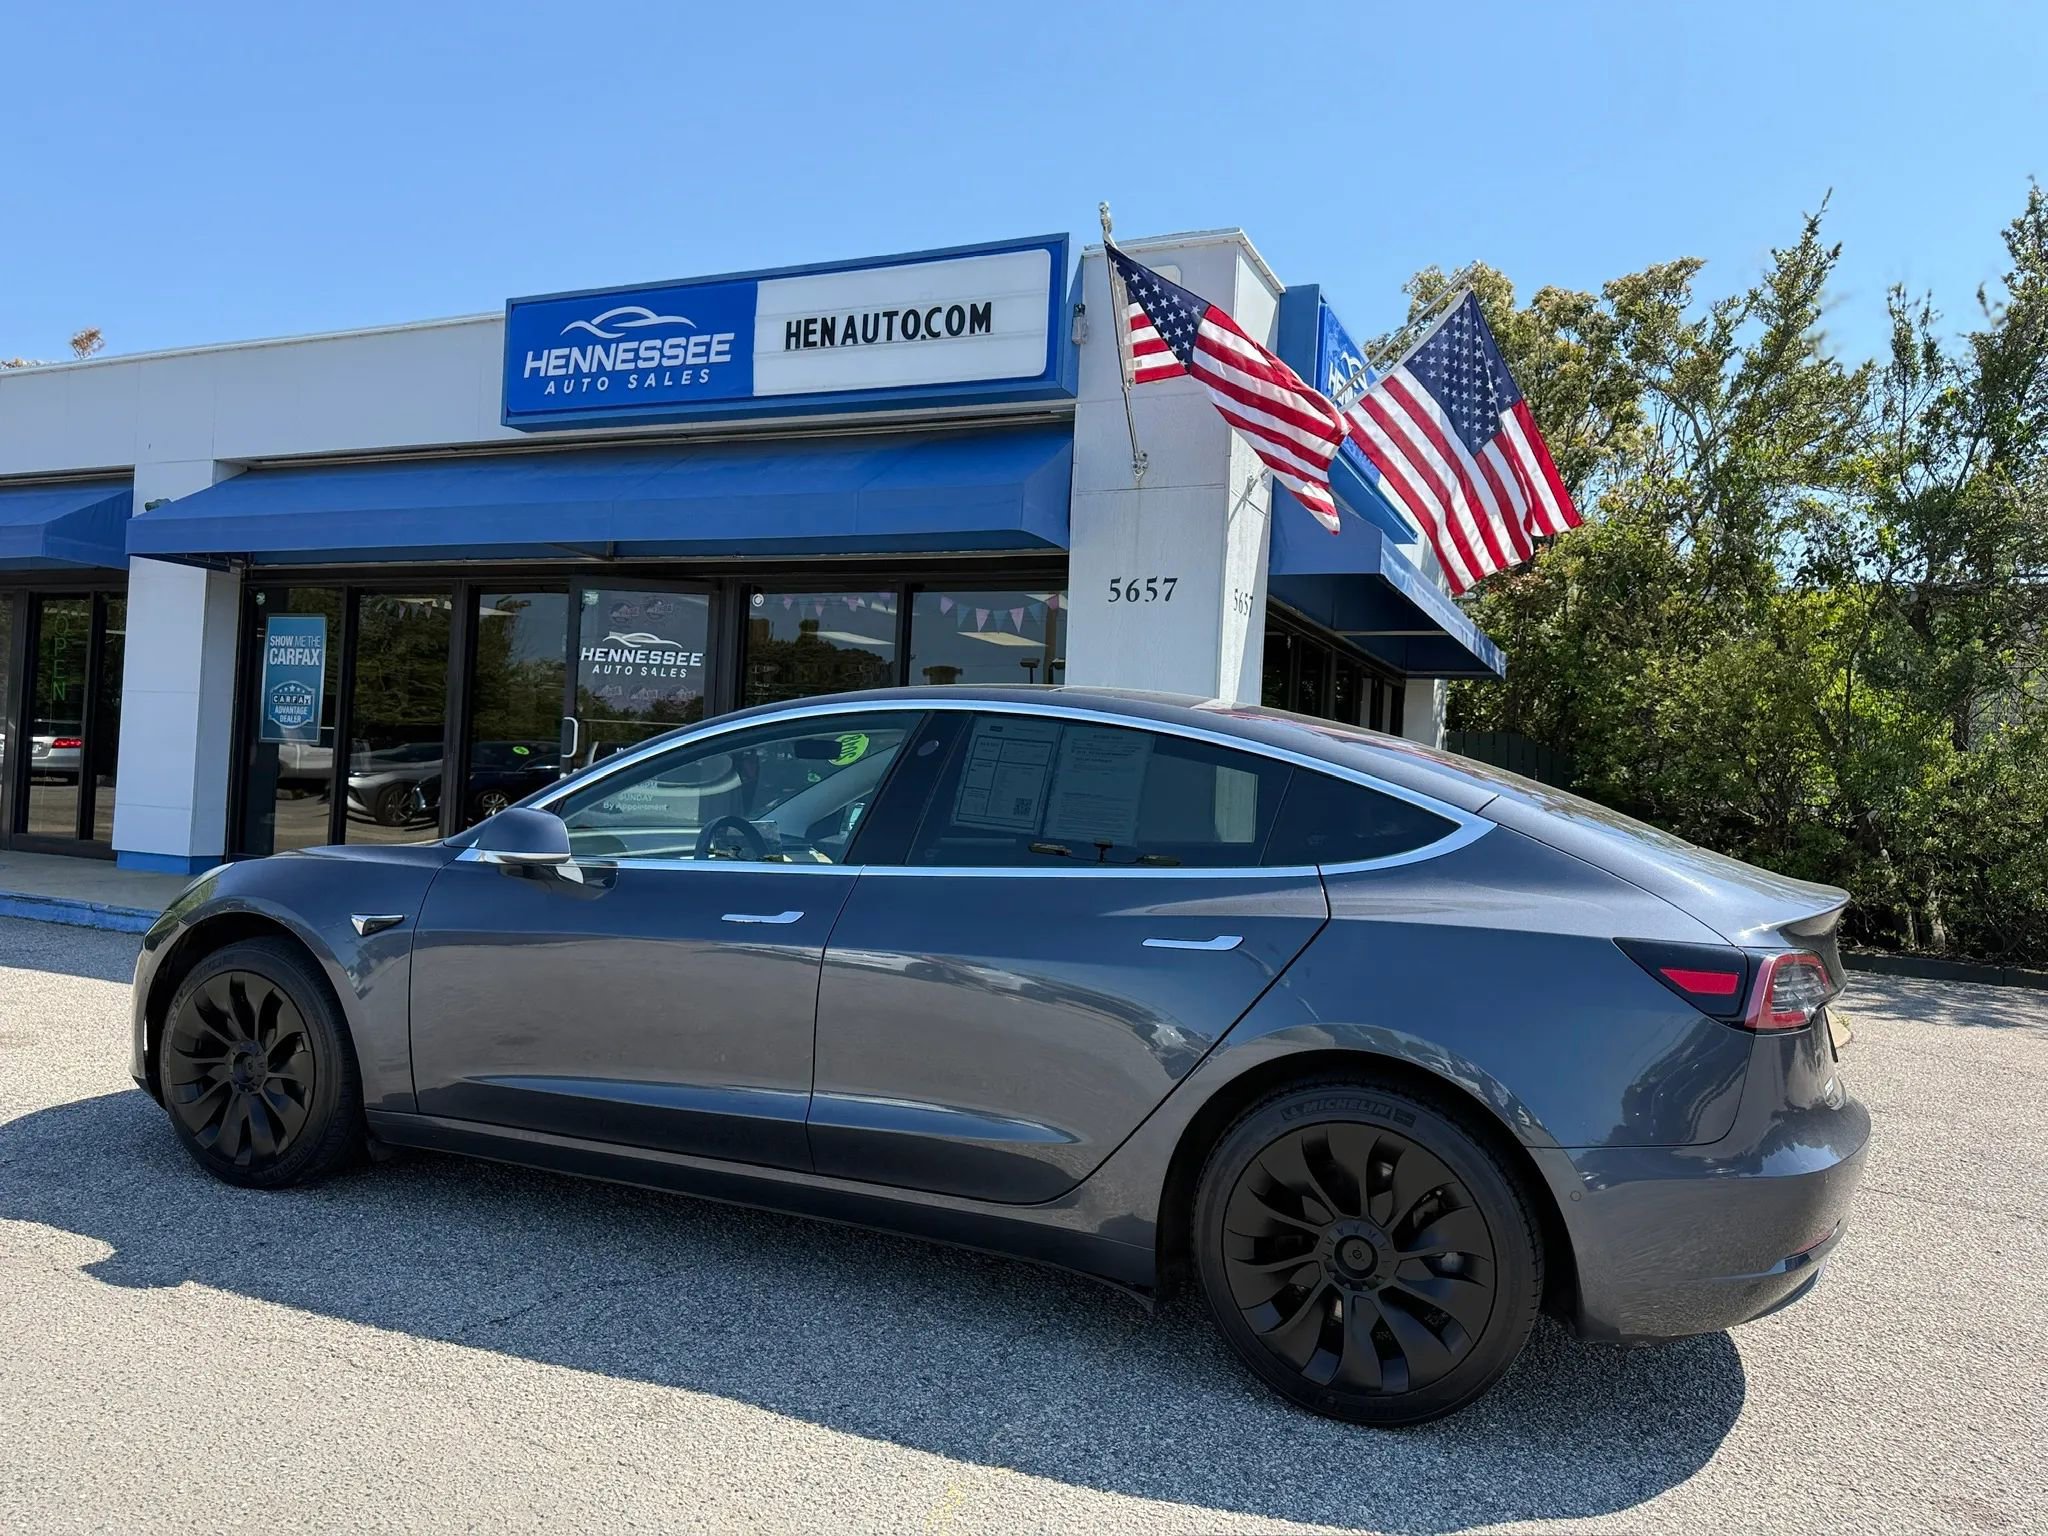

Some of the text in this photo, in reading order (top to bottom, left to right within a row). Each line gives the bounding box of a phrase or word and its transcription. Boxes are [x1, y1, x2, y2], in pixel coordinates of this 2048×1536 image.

[523, 332, 735, 378] HENNESSEE
[544, 368, 710, 395] AUTO SALES
[1108, 576, 1178, 602] 5657
[1233, 588, 1253, 618] 5657
[270, 635, 320, 648] SHOW ME THE
[52, 615, 69, 701] OPEN
[269, 648, 320, 666] CARFAX
[580, 647, 703, 667] HENNESSEE
[592, 664, 688, 679] AUTO SALES
[274, 705, 308, 715] ADVANTAGE
[279, 714, 302, 723] DEALER
[603, 801, 614, 810] By
[1303, 1098, 1392, 1119] MICHELIN
